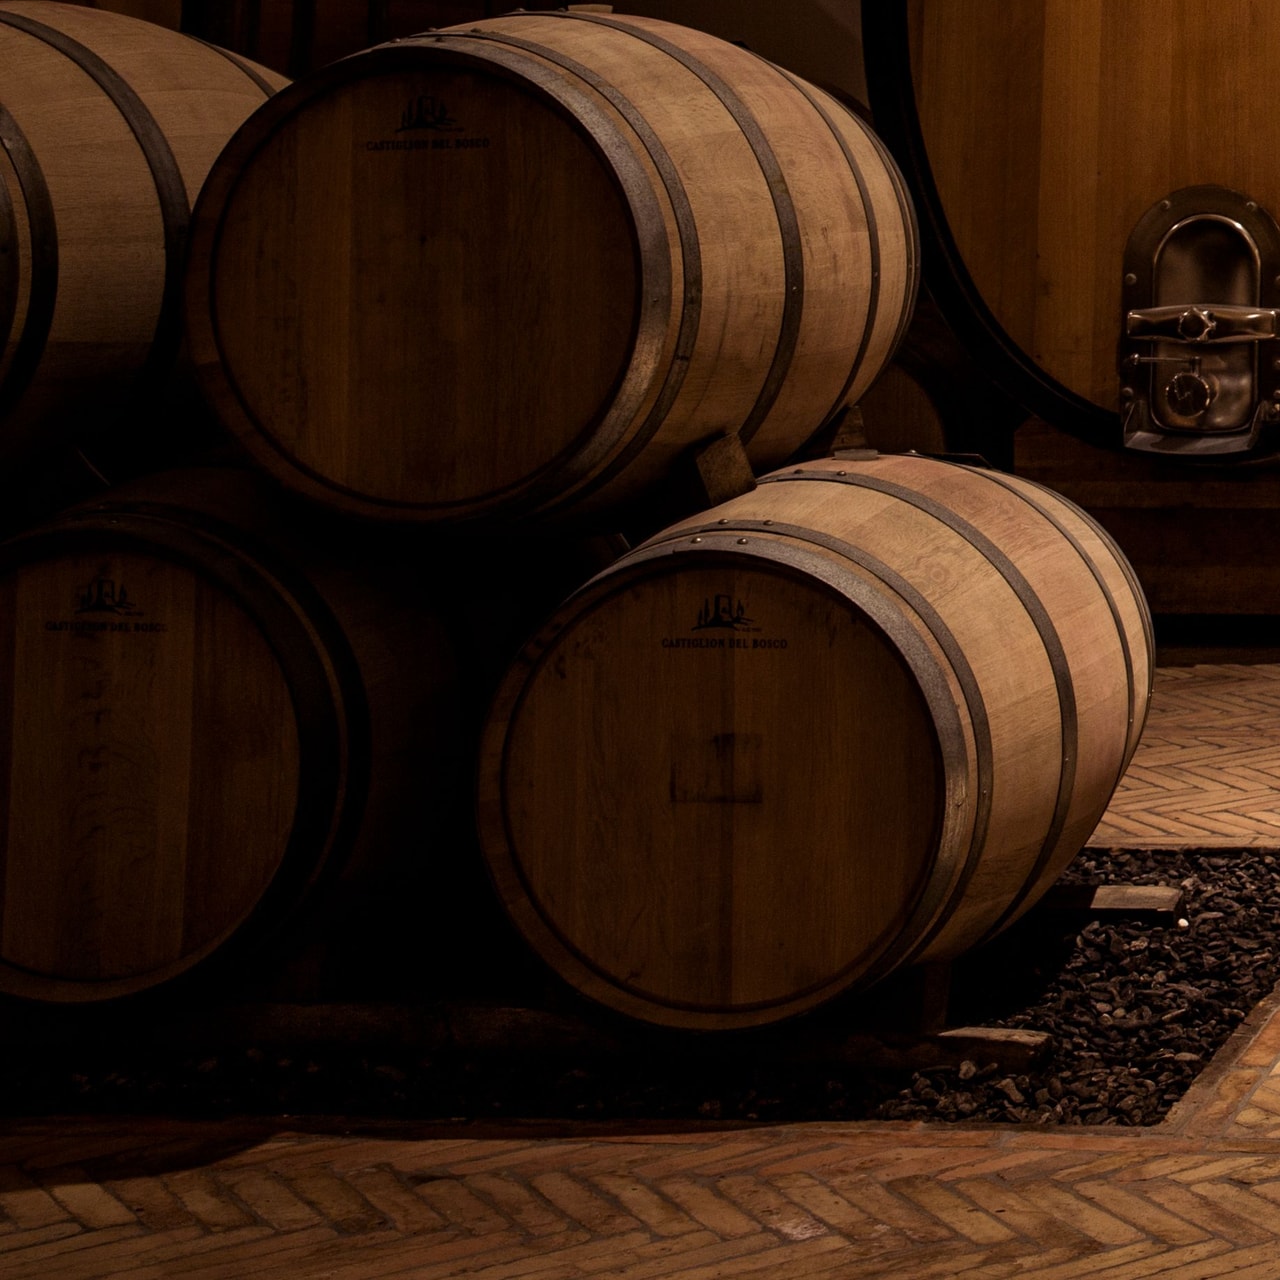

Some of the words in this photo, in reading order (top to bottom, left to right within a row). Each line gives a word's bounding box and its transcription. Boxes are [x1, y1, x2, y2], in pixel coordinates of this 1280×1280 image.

[661, 638, 726, 649] CASTIGLION
[729, 638, 748, 649] DEL
[752, 638, 788, 649] BOSCO
